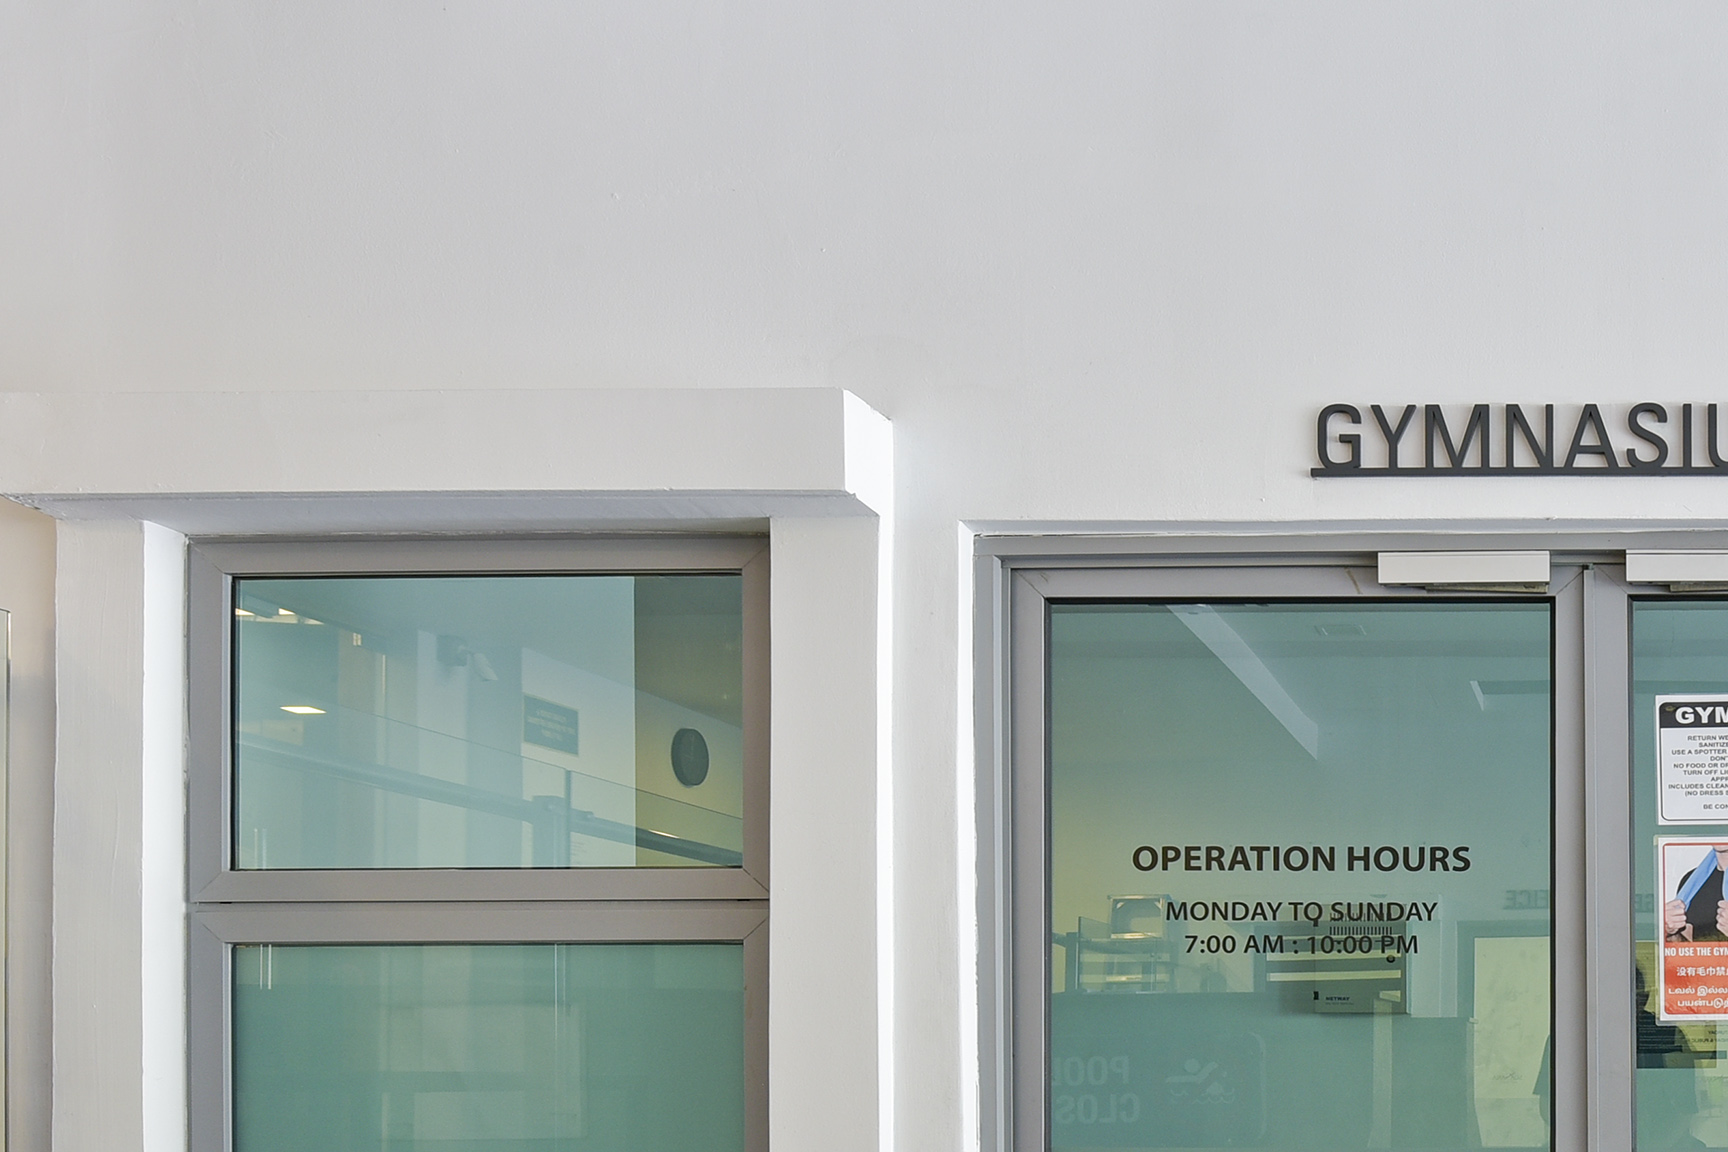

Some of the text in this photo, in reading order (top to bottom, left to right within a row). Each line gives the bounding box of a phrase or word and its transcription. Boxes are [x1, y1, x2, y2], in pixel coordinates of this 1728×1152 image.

[1132, 845, 1472, 873] OPERATION HOURS
[1166, 901, 1438, 922] MONDAY TO SUNDAY
[1185, 934, 1236, 954] 7:00
[1243, 934, 1284, 954] AM
[1308, 934, 1373, 954] 10:00
[1380, 934, 1418, 954] PM
[1665, 947, 1676, 956] NO
[1678, 947, 1694, 956] USE
[1696, 947, 1712, 956] THE
